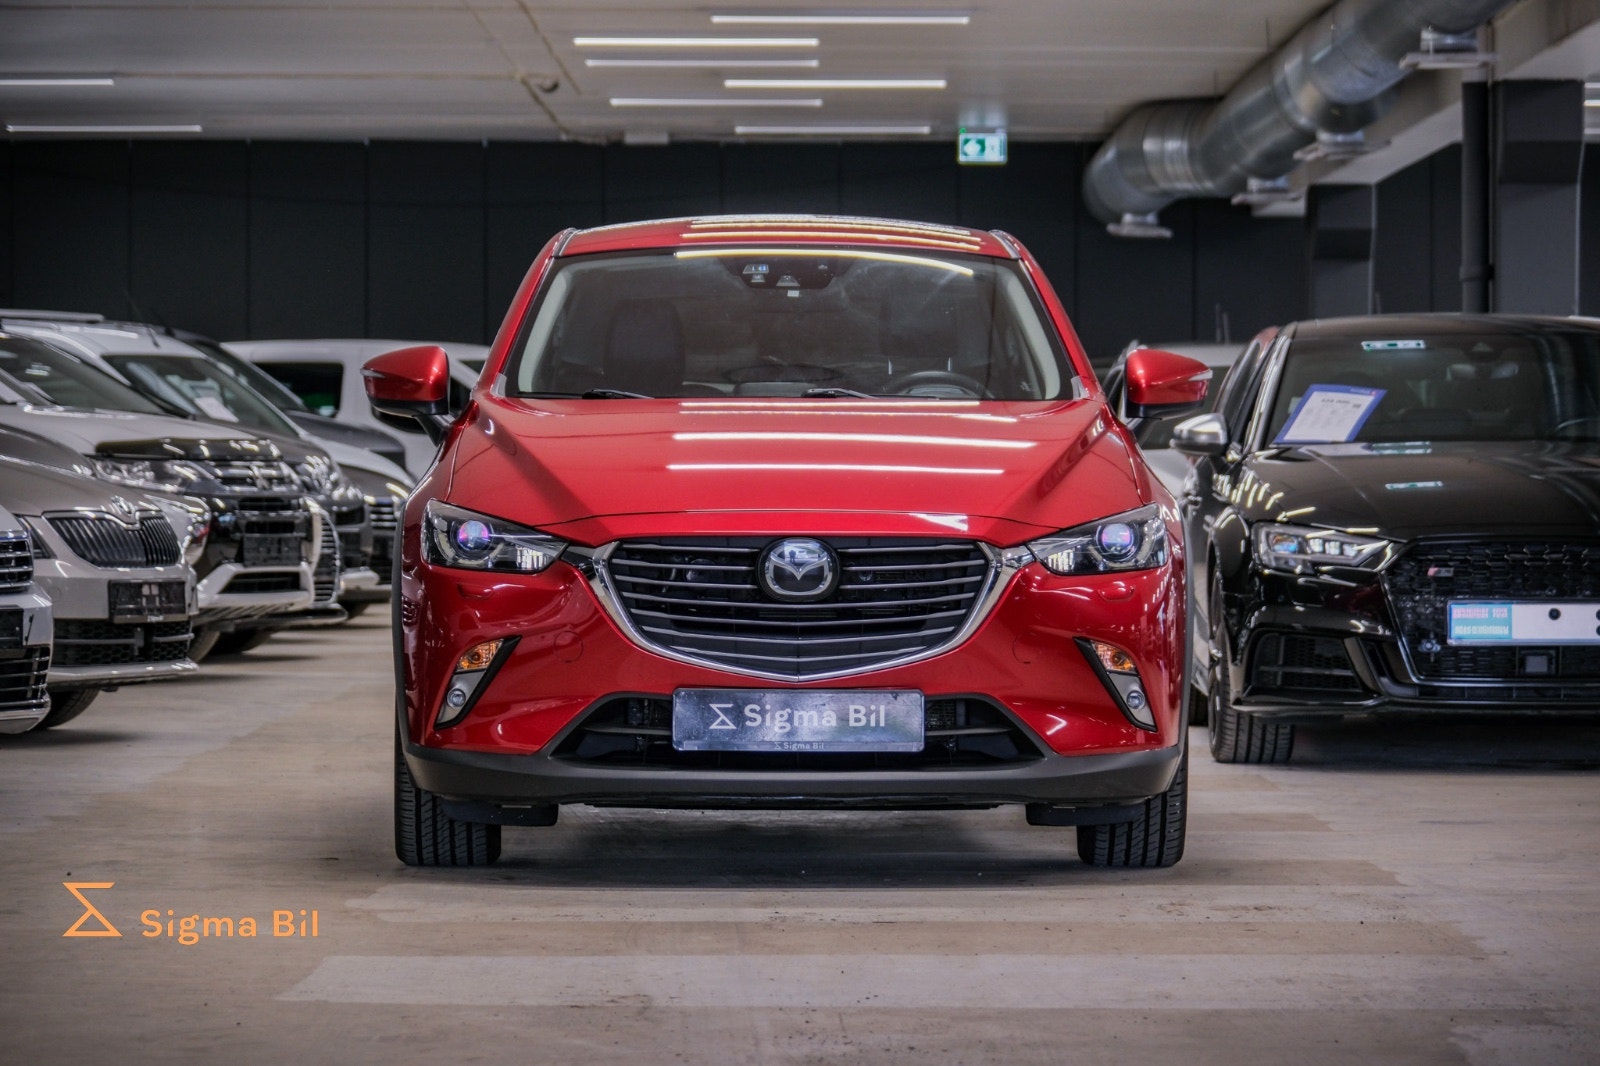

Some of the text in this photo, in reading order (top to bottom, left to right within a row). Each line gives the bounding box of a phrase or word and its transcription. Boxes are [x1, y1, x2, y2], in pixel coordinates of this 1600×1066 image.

[743, 704, 886, 733] Sigma Bil
[783, 742, 824, 751] Sigma Bil
